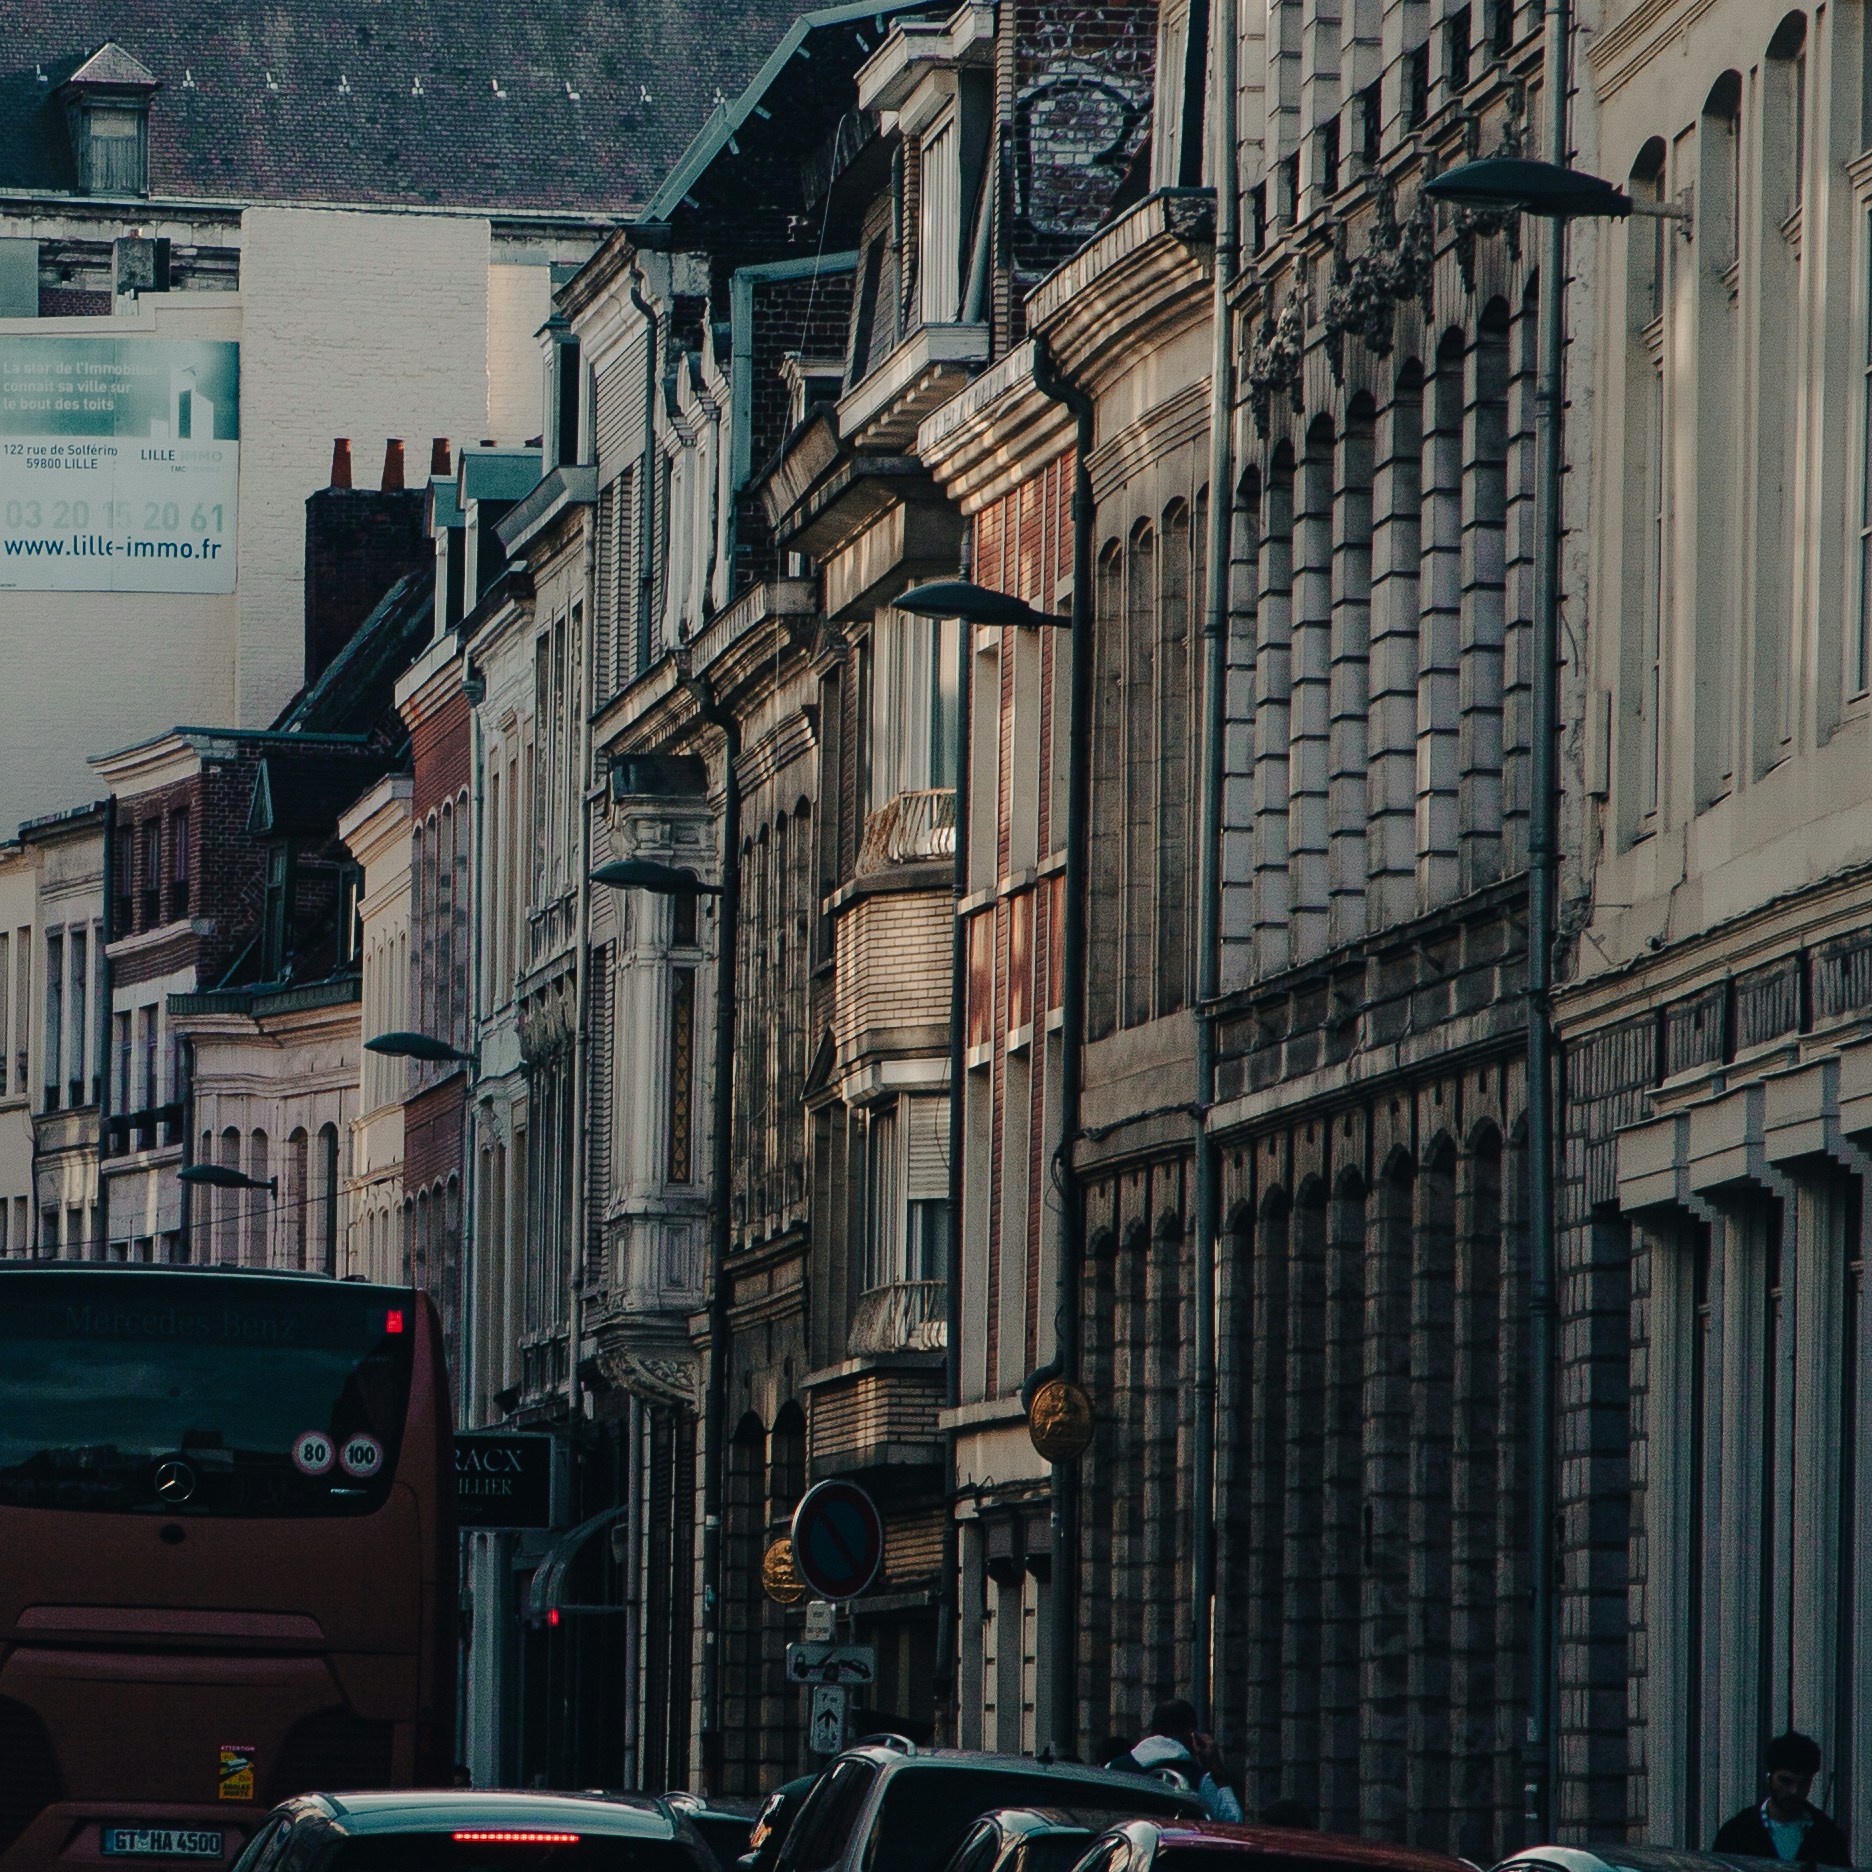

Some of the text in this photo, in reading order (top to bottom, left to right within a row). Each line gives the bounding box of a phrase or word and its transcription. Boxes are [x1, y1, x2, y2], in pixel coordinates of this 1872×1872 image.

[3, 362, 20, 375] La
[56, 362, 72, 375] de
[58, 384, 74, 394] sa
[77, 381, 107, 394] ville
[111, 383, 132, 394] sur
[3, 398, 114, 411] le bout des toits
[4, 444, 24, 455] 122
[27, 445, 47, 455] rue
[50, 444, 65, 455] de
[140, 449, 175, 461] LILLE
[26, 458, 98, 469] 59800 LILLE
[5, 499, 42, 529] 03
[51, 499, 90, 529] 20
[142, 500, 180, 532] 20
[189, 502, 225, 533] 61
[3, 534, 223, 560] www.lille-immo.fr
[304, 1443, 326, 1462] 80
[348, 1444, 375, 1464] 100
[115, 1831, 221, 1852] GT HA 4500
